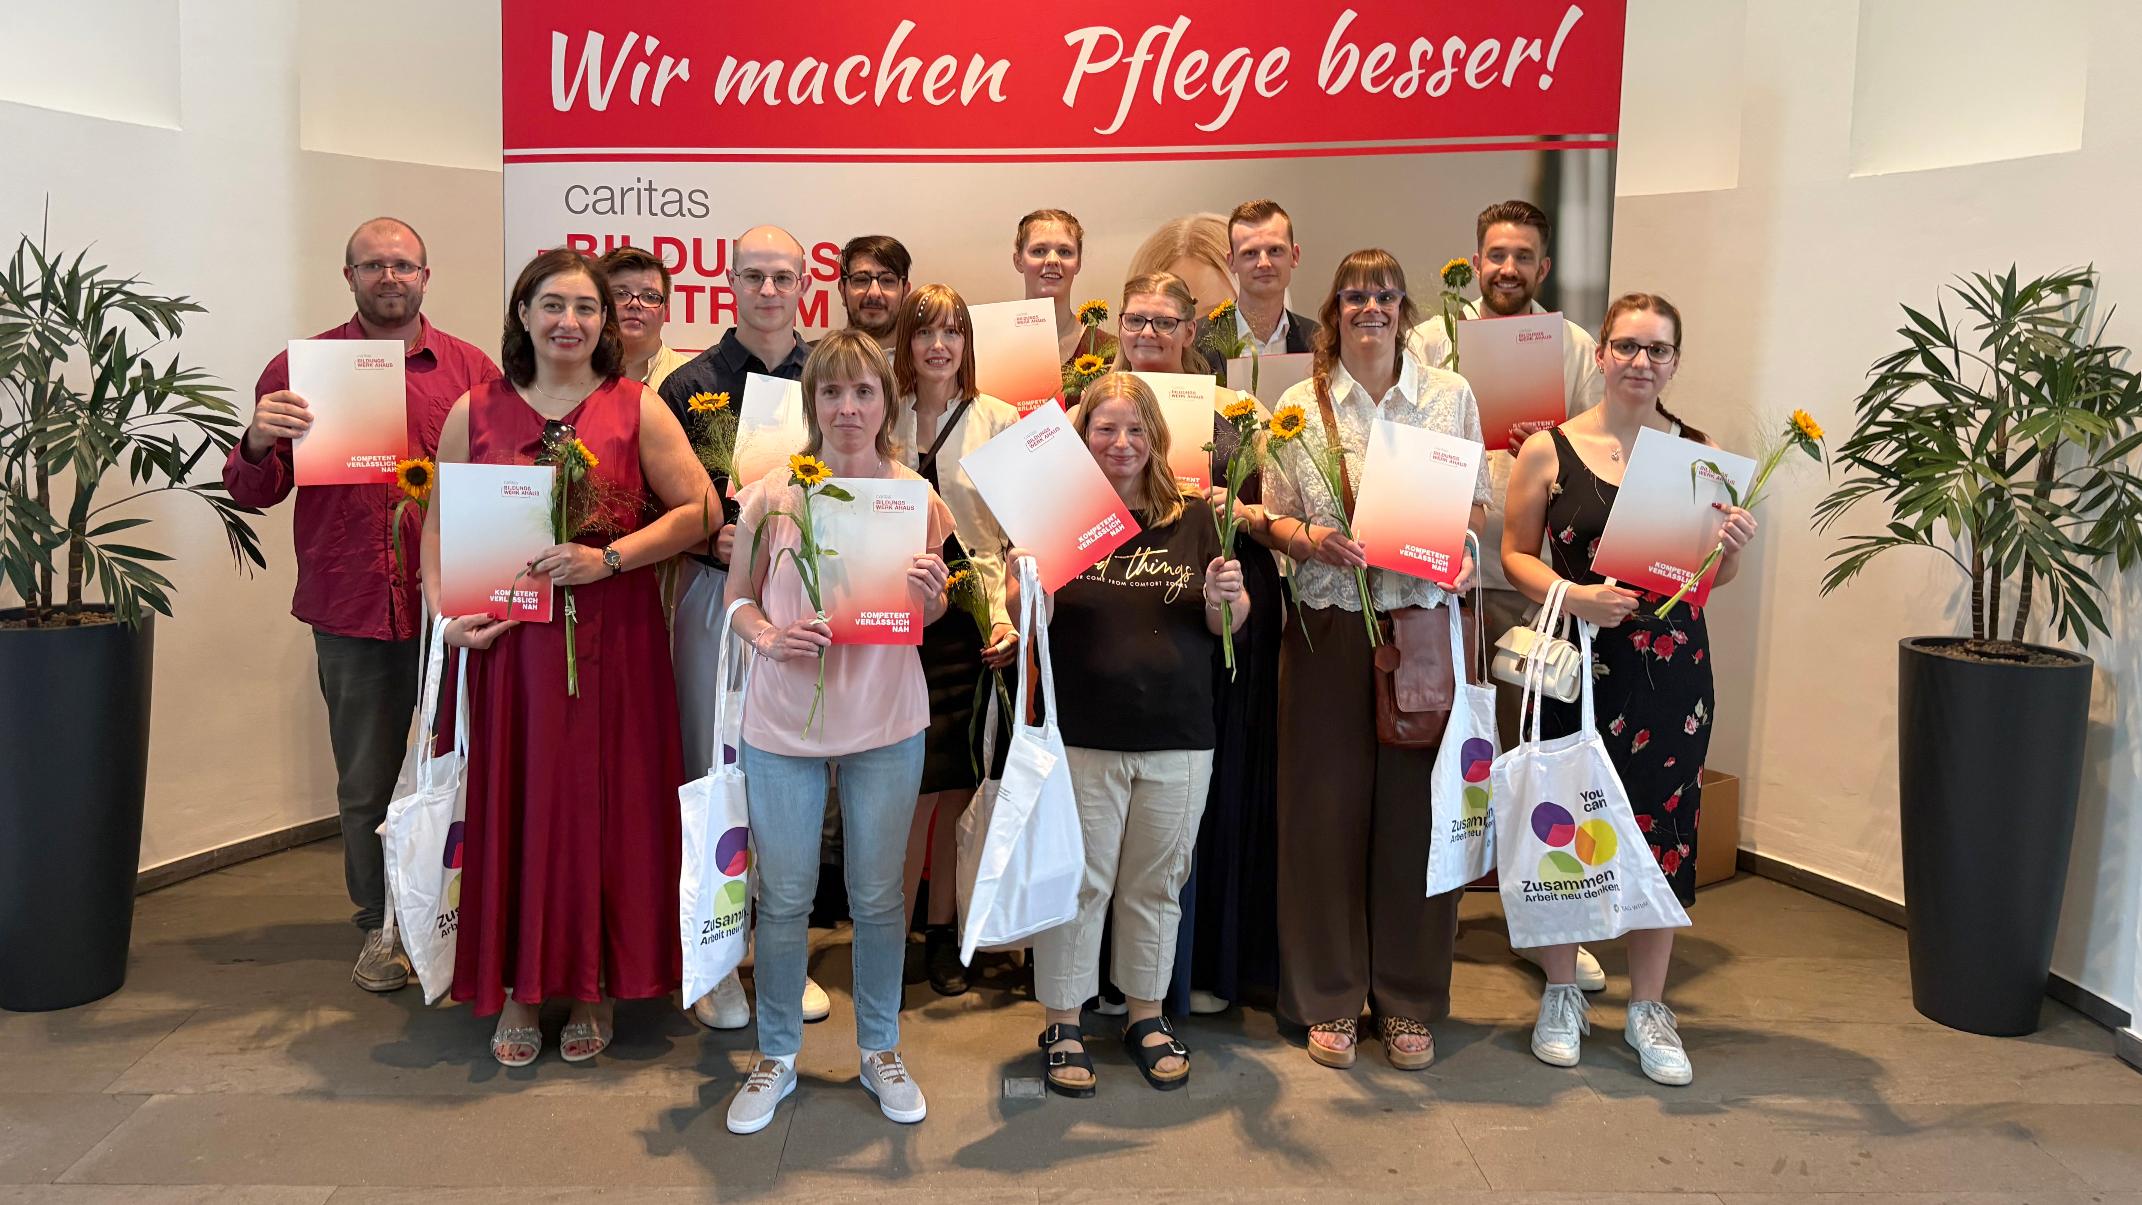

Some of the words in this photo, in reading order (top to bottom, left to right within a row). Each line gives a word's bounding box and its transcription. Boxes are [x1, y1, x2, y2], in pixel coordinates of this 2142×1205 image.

[551, 30, 690, 112] Wir
[714, 19, 1012, 108] machen
[1062, 14, 1291, 135] Pflege
[1317, 4, 1584, 99] besser!
[565, 177, 710, 218] caritas
[1078, 512, 1118, 544] KOMPETENT
[1109, 524, 1126, 538] NAH
[1405, 544, 1450, 560] KOMPETENT
[1114, 546, 1195, 604] things
[1431, 563, 1448, 573] NAH
[1654, 561, 1698, 578] KOMPETEN
[1108, 579, 1127, 587] FROM
[490, 595, 538, 604] VERLSSLICH
[892, 625, 910, 633] NAH
[1580, 788, 1605, 802] You
[1583, 797, 1607, 812] can
[1521, 869, 1615, 893] Zusammen
[1525, 892, 1559, 903] Arbeit
[1561, 893, 1582, 901] neu
[1584, 882, 1621, 899] denken
